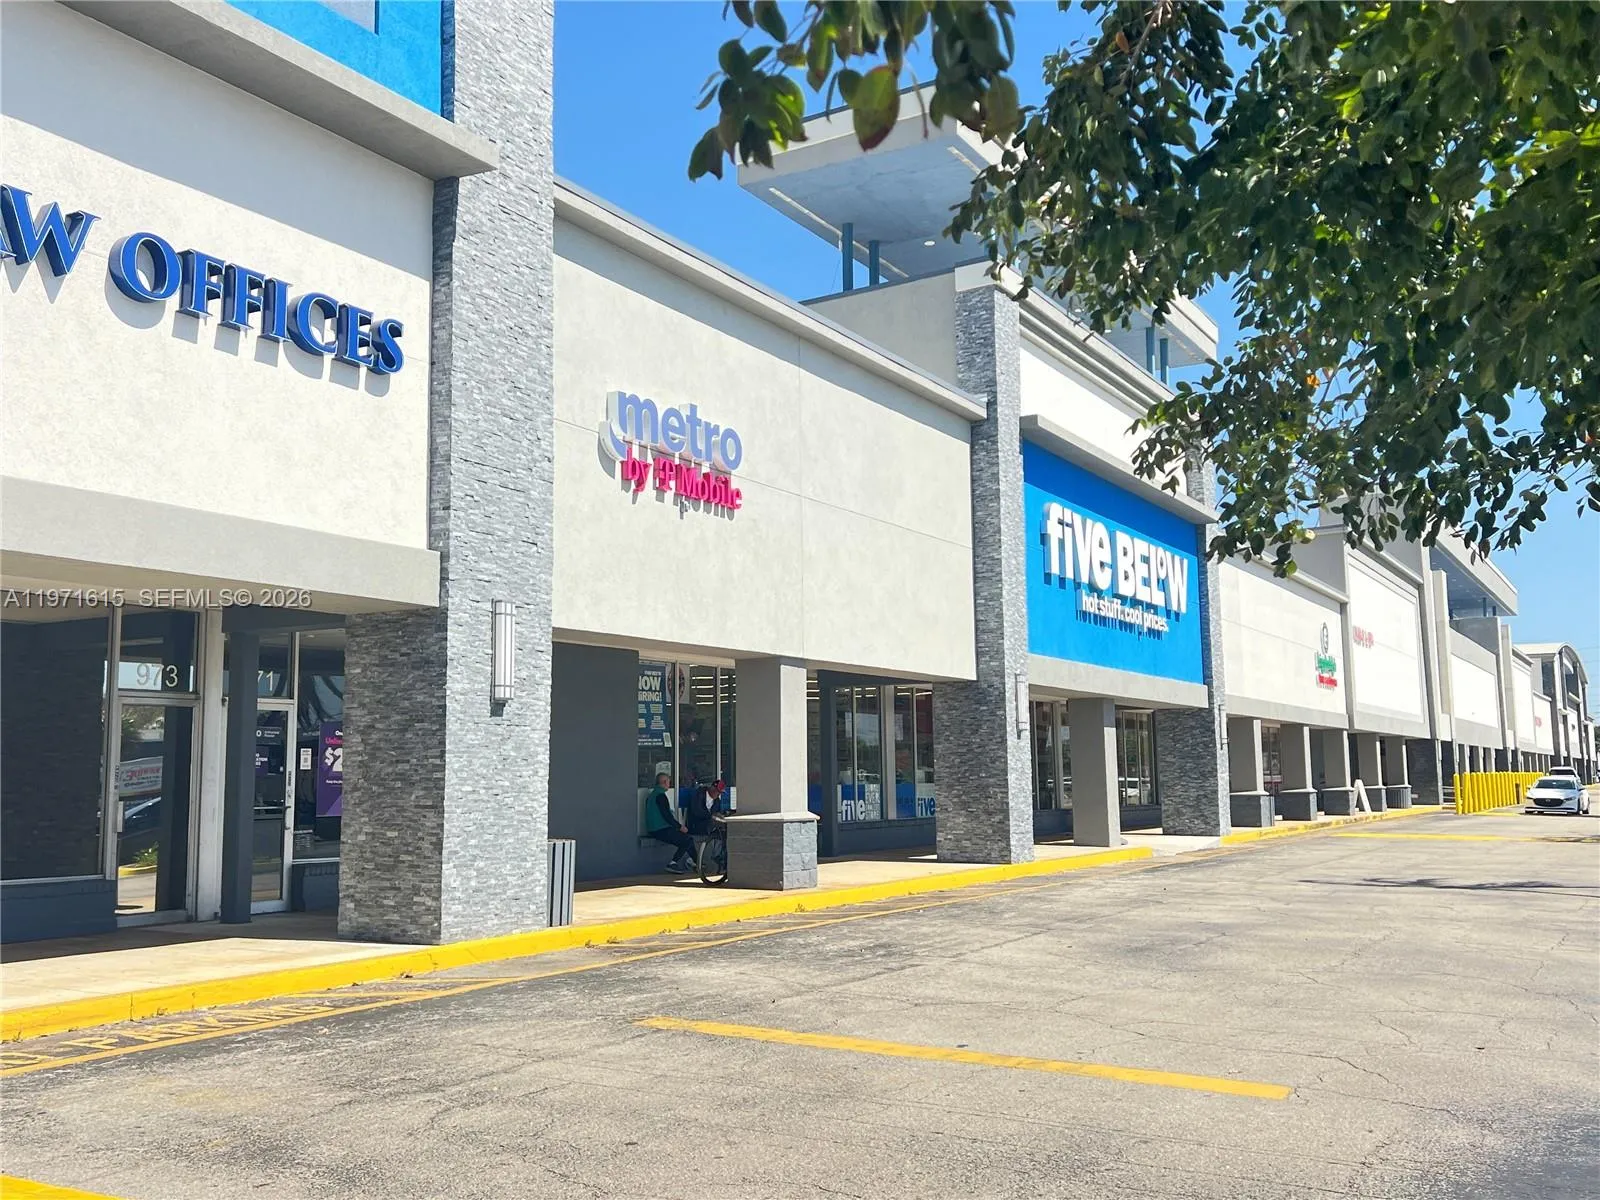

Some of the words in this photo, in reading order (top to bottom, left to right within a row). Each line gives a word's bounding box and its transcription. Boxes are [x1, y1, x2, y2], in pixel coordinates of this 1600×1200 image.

[0, 184, 101, 277] W
[108, 231, 404, 376] OFFICES
[606, 390, 743, 472] metro
[620, 447, 651, 493] by
[1042, 502, 1112, 591] five
[1113, 530, 1188, 614] BELOW
[1081, 589, 1099, 614] hot
[1100, 596, 1124, 621] stuff.
[1125, 605, 1143, 625] cool
[1144, 609, 1169, 633] prices.
[136, 663, 178, 687] 973
[842, 799, 866, 821] five
